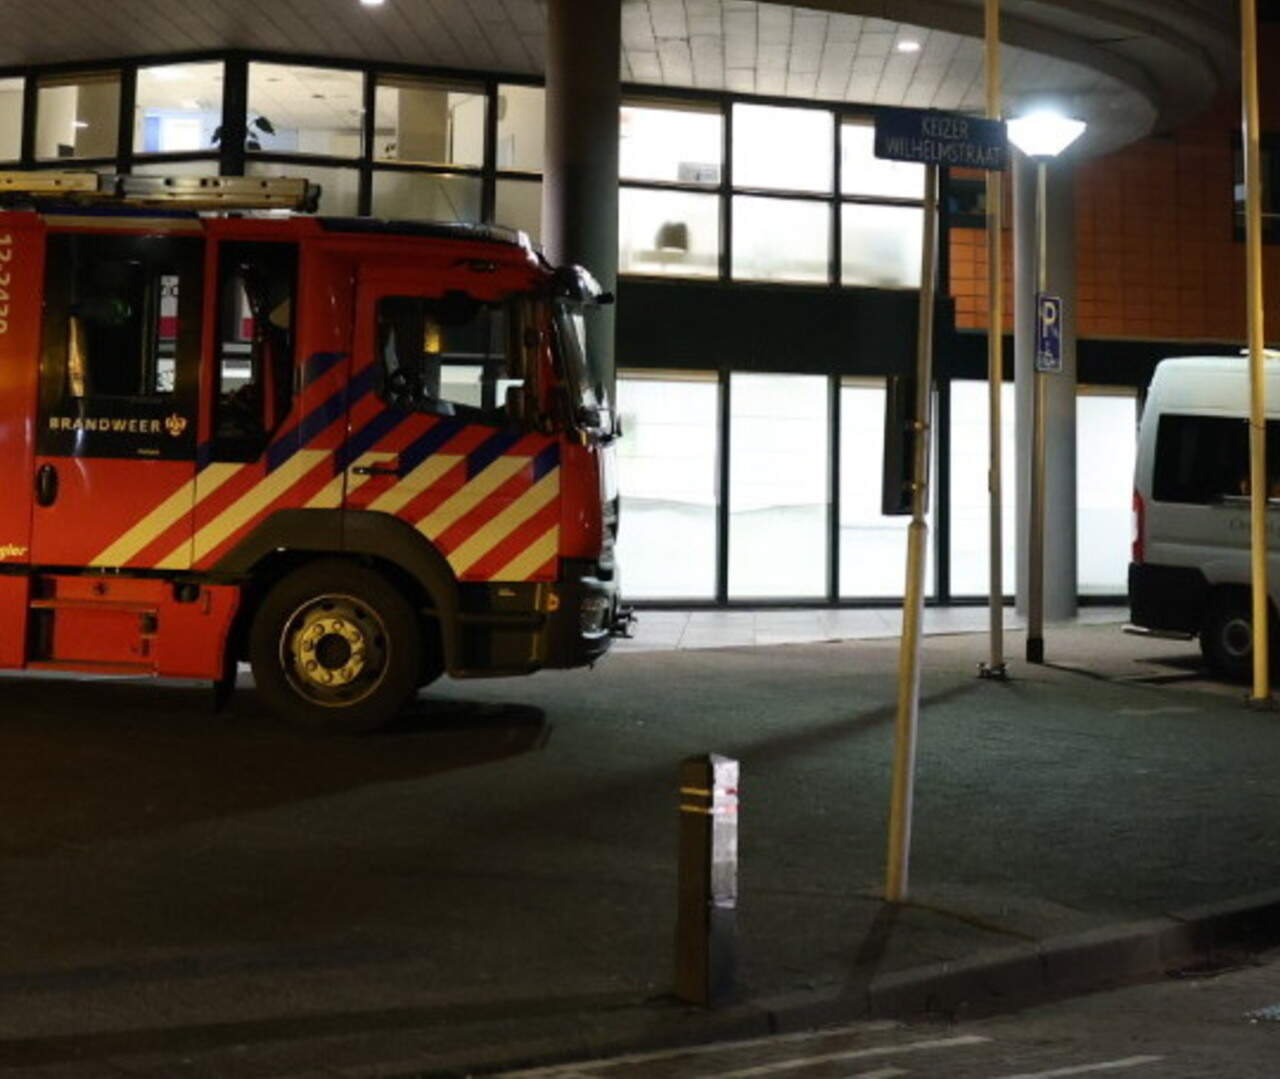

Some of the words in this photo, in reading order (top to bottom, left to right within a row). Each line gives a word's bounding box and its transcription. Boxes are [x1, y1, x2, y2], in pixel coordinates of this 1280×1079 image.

[921, 119, 968, 138] KEIZER
[885, 136, 1002, 164] WILHELMSTRAAT
[48, 416, 161, 433] BRANDWEER
